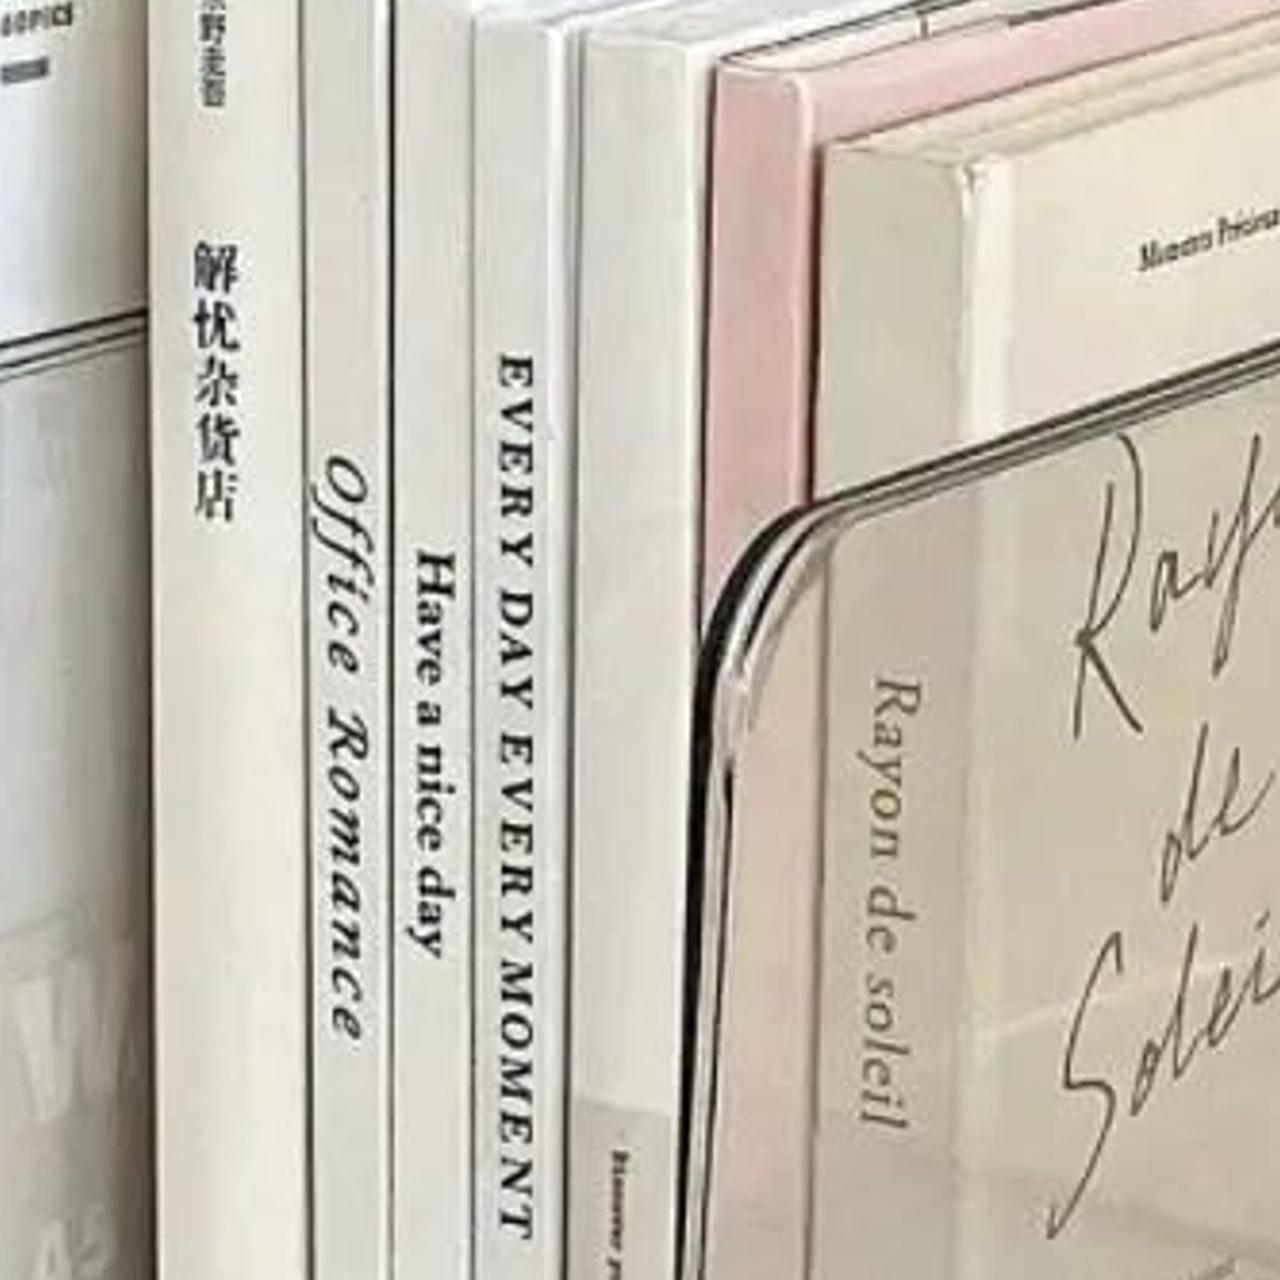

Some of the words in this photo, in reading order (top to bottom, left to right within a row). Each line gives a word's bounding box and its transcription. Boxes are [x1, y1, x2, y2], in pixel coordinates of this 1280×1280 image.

[192, 240, 241, 523] 解忧杂货店
[499, 353, 535, 569] EVERY
[311, 454, 376, 676] Office
[415, 549, 457, 687] Have
[499, 588, 535, 711] DAY
[415, 699, 442, 727] a
[415, 743, 457, 852] nice
[855, 677, 923, 859] Rayon
[326, 705, 370, 1041] Romance
[405, 864, 458, 959] day
[499, 731, 535, 945] EVERY
[864, 884, 919, 954] de
[499, 959, 535, 1240] MOMENT
[858, 972, 911, 1131] soleil
